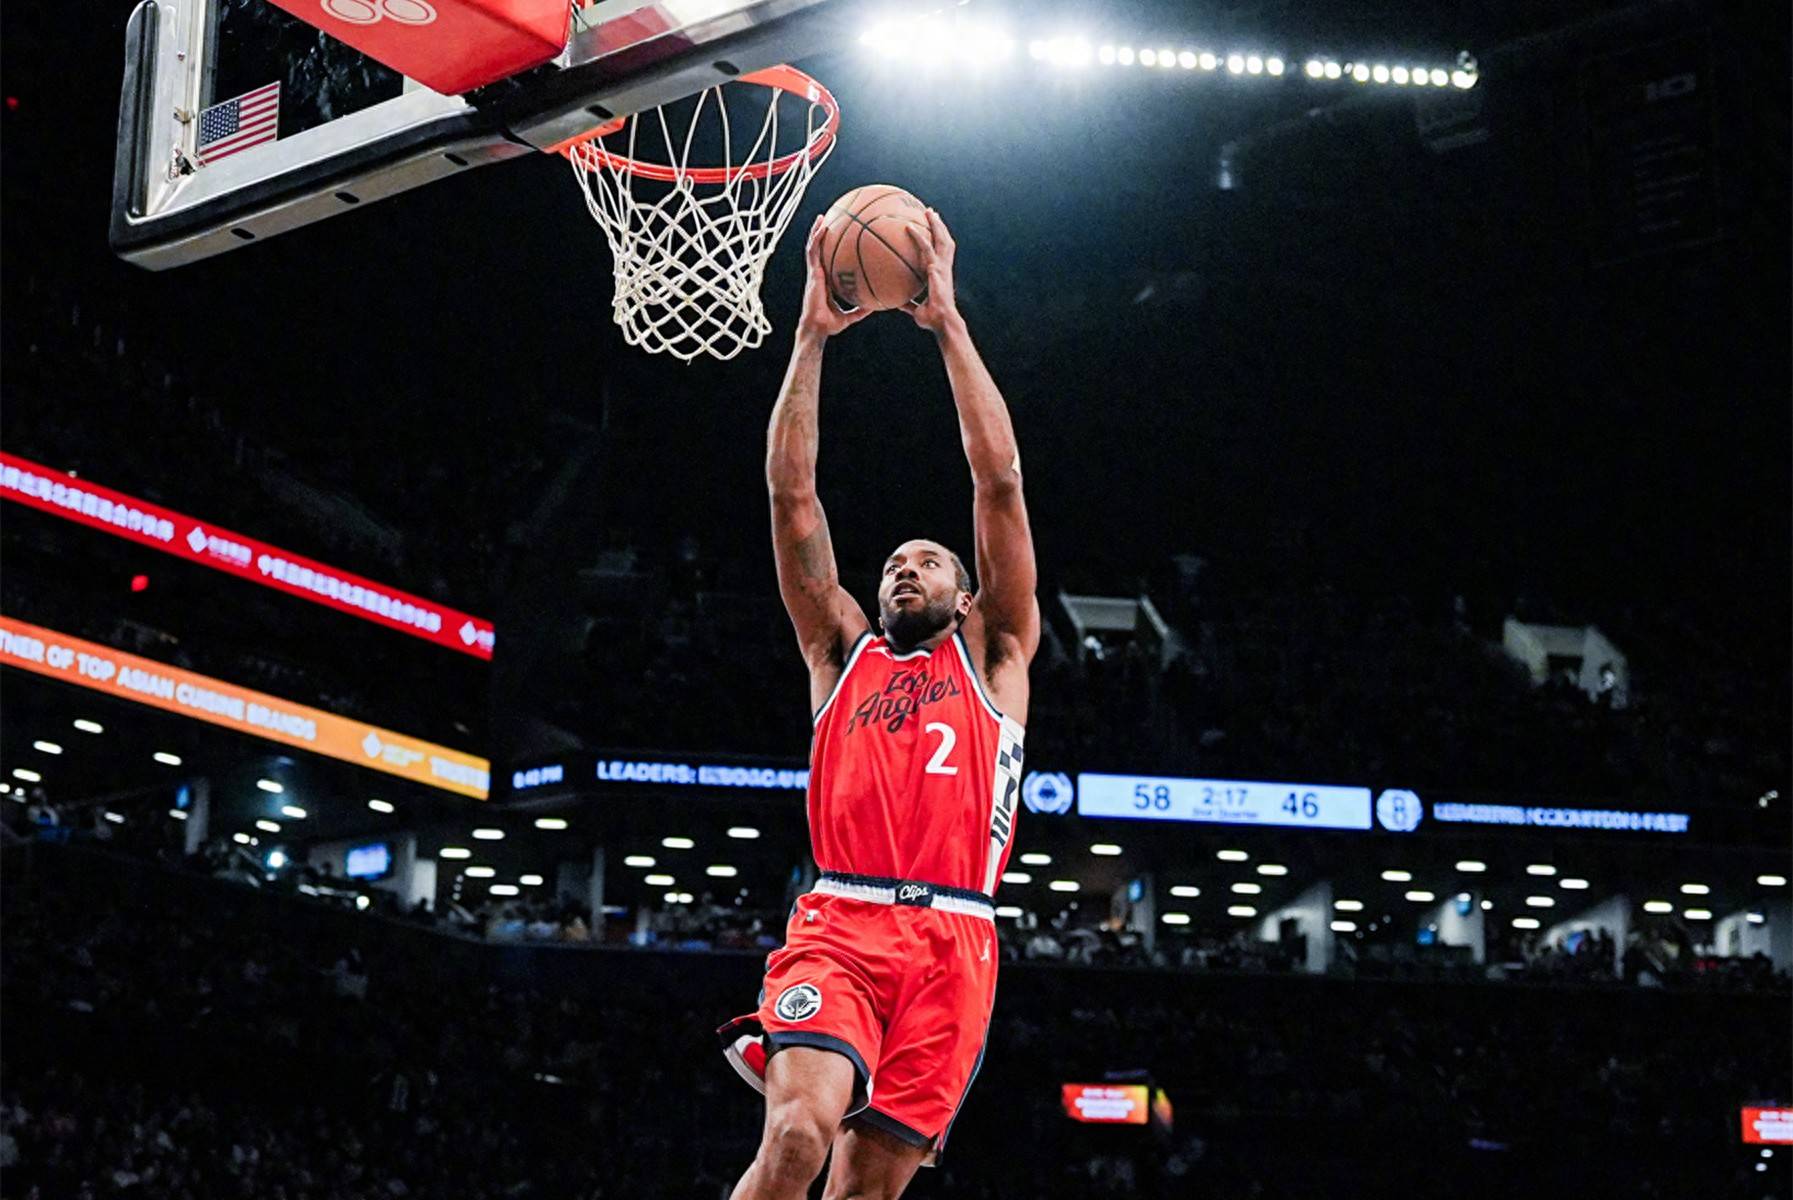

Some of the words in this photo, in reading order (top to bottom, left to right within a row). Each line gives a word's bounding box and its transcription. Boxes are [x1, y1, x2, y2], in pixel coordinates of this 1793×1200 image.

[46, 645, 75, 669] OF
[77, 653, 116, 681] TOP
[924, 722, 958, 776] 2
[597, 760, 697, 784] LEADERS:
[1133, 784, 1170, 811] 58
[1202, 787, 1248, 807] 2:17
[1282, 792, 1319, 818] 46
[899, 884, 929, 901] Clips
